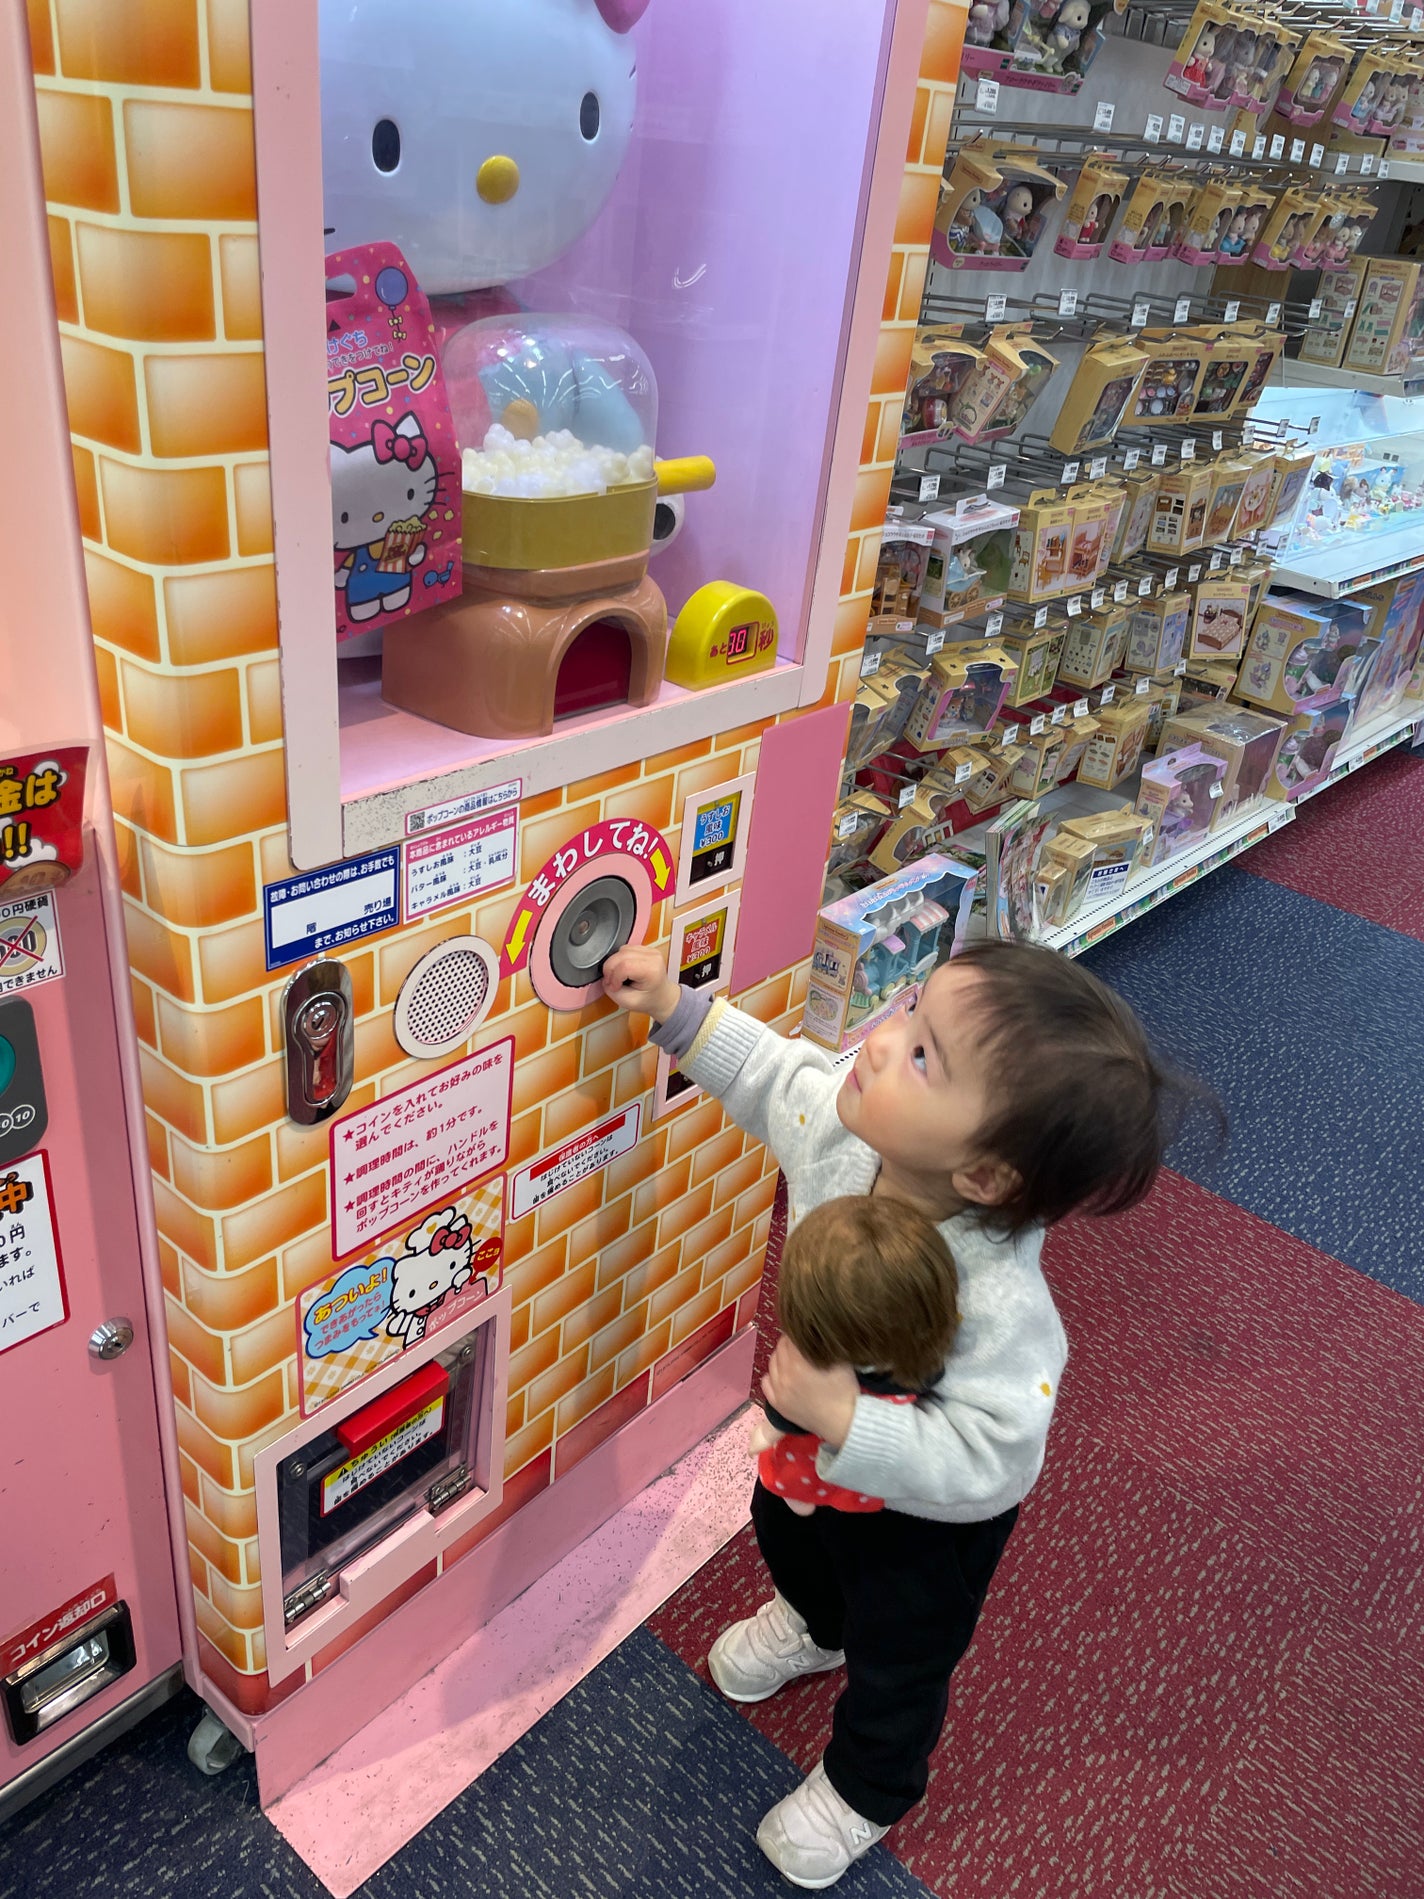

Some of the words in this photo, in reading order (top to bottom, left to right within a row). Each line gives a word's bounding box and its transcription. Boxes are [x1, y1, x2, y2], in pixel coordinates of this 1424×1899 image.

[328, 355, 436, 416] プコーン
[710, 642, 727, 658] あと
[759, 628, 774, 651] 秒
[0, 770, 58, 815] 金は
[701, 805, 730, 825] うすしお
[0, 895, 49, 918] 0円硬貨
[314, 913, 395, 949] まで、お知らせ下さい。
[0, 965, 58, 992] できません
[356, 1053, 503, 1136] コインを入れてお好みの味を
[15, 1110, 30, 1123] 10
[355, 1099, 443, 1151] 選んでください。
[540, 1134, 613, 1182] はじけていないコーンは
[546, 1148, 609, 1188] 食べないでください。
[356, 1140, 486, 1219] 回すとキティが踊りながら
[356, 1144, 502, 1233] ポップコーンを作ってくれます。
[320, 1292, 382, 1335] できあがったら
[429, 1290, 484, 1331] ポップコーン
[10, 1590, 106, 1663] コイン返却口
[851, 1822, 872, 1846] N
